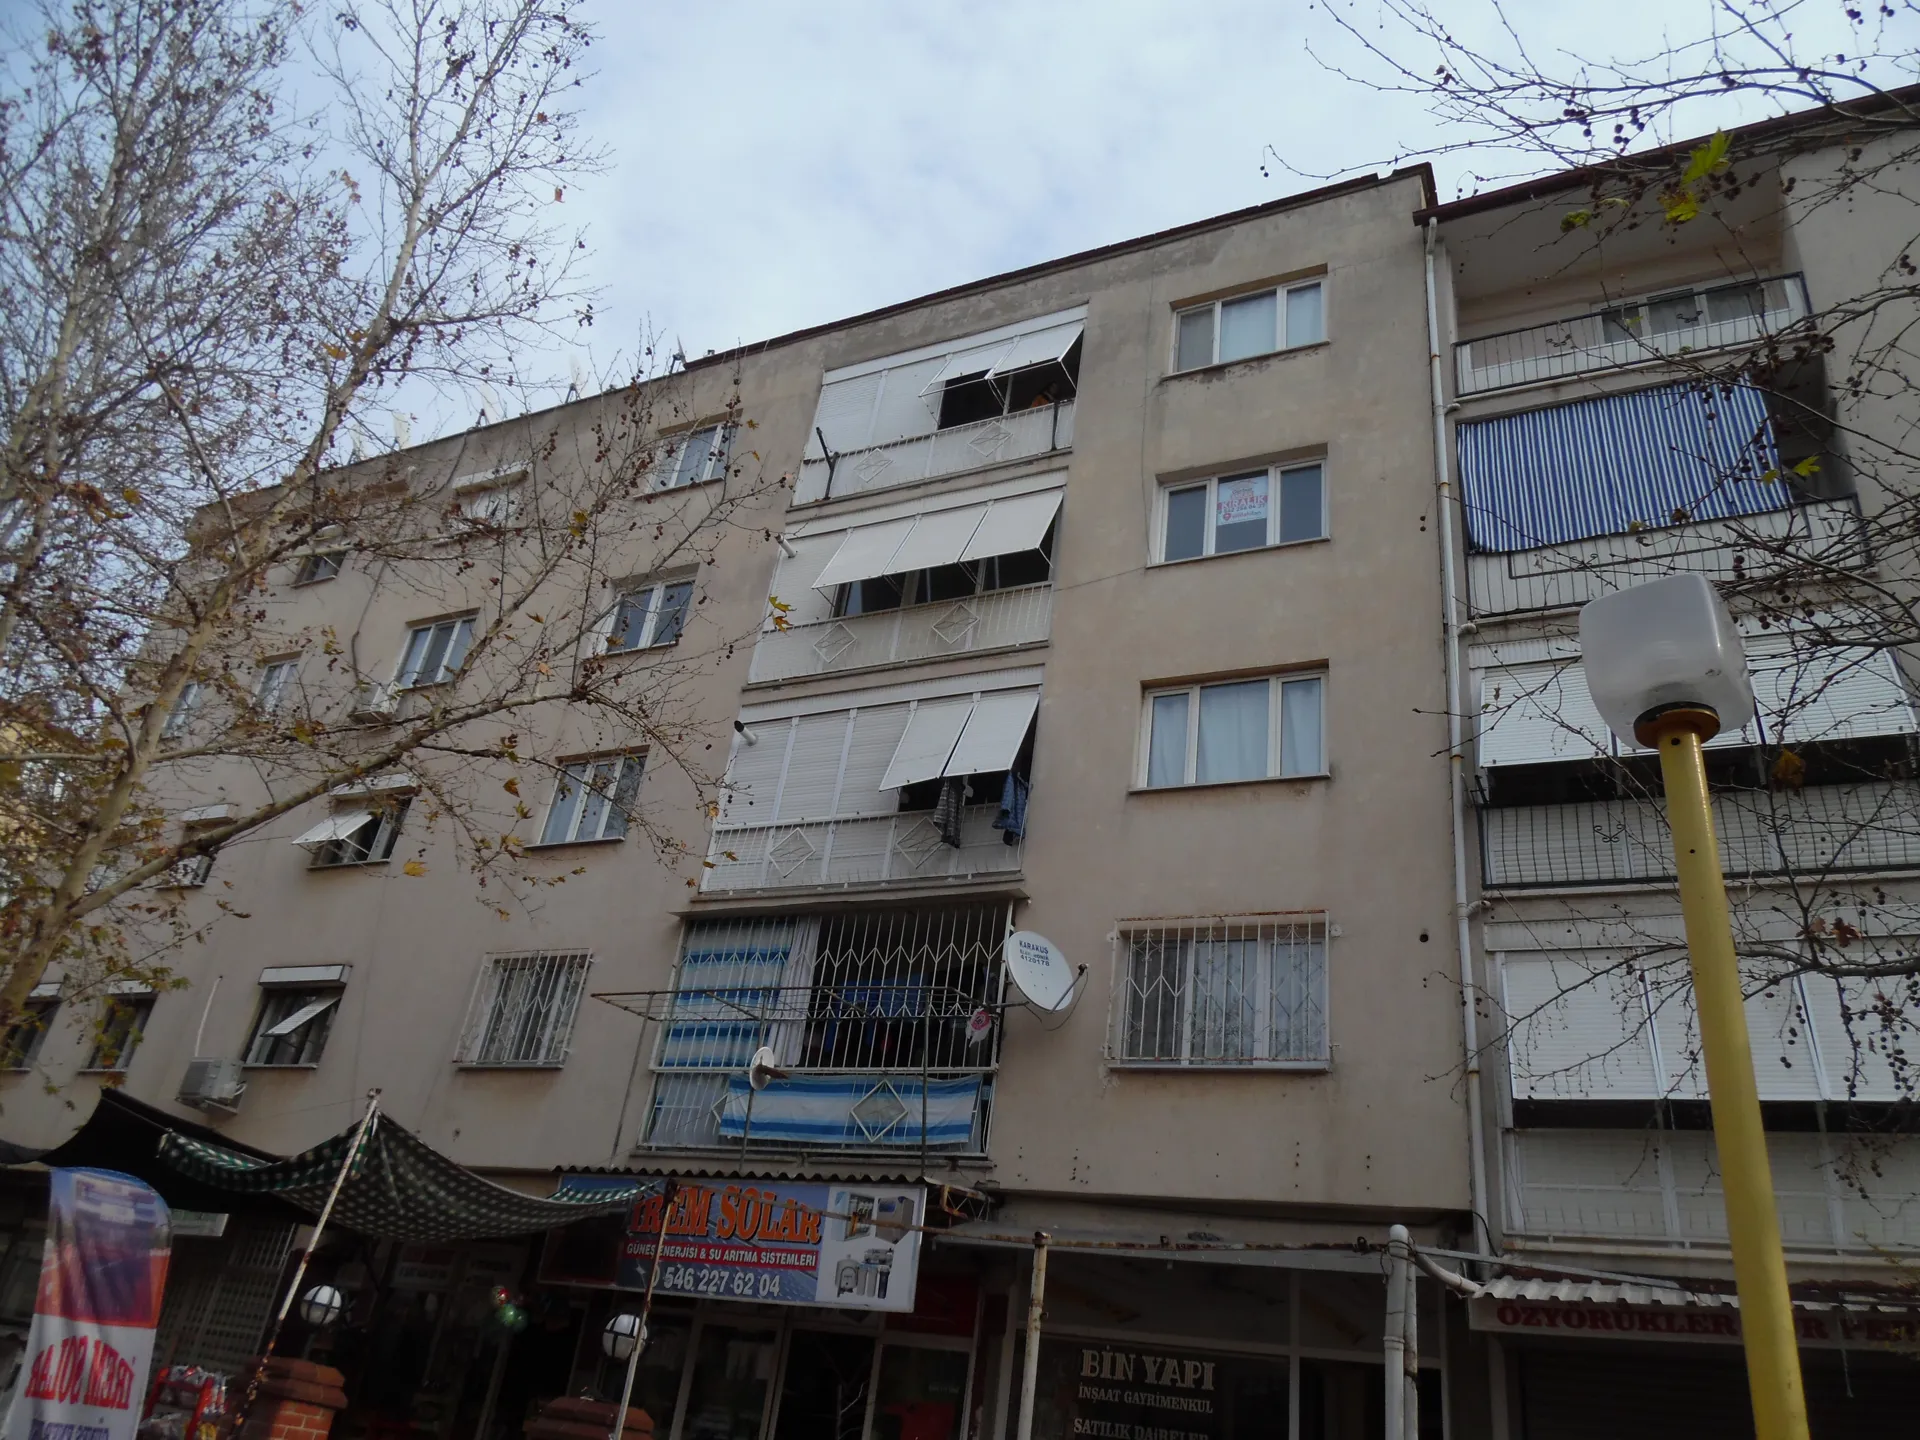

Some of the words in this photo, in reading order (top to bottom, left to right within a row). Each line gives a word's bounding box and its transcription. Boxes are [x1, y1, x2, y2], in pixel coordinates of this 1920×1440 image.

[1221, 495, 1266, 509] KIRALIK
[630, 1184, 714, 1237] İREM
[715, 1185, 822, 1244] SOLAR
[626, 1241, 656, 1260] GÜNEŞ
[658, 1243, 698, 1260] ENERJİSİ
[700, 1247, 707, 1259] &
[709, 1248, 722, 1260] SU
[723, 1251, 759, 1264] ARITMA
[759, 1250, 817, 1268] SİSTEMLERİ
[663, 1266, 694, 1290] 546
[697, 1269, 729, 1293] 227
[732, 1271, 754, 1294] 62
[758, 1273, 781, 1297] 04
[1496, 1300, 1739, 1336] ÖZYÖRÜKLER
[1080, 1344, 1136, 1383] BİN
[1141, 1355, 1216, 1391] YAPI
[1078, 1382, 1122, 1404] İNŞAAT
[1123, 1391, 1214, 1414] GAYRİMENKUL
[1073, 1417, 1132, 1440] SATILIK
